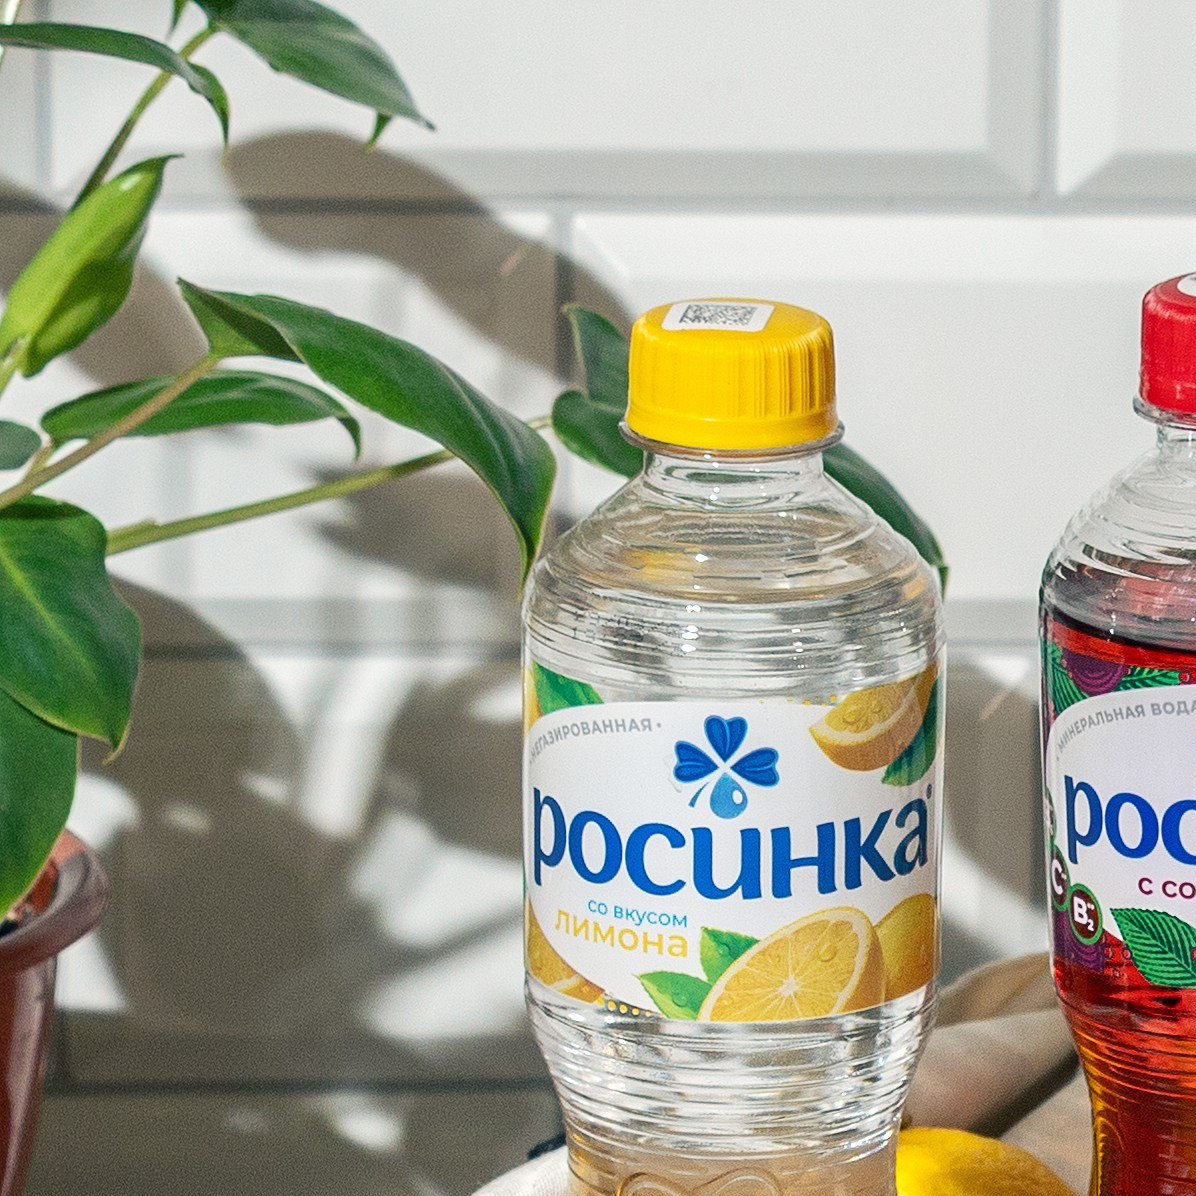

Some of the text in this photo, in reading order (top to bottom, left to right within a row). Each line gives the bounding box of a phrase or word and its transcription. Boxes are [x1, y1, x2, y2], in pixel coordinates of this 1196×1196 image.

[531, 718, 653, 760] НЕГАЗИРОВАННАЯ
[1057, 704, 1146, 753] МИНЕРАЛЬНАЯ
[532, 786, 930, 900] росинка
[554, 909, 688, 958] лимона
[587, 899, 688, 928] со вкусом
